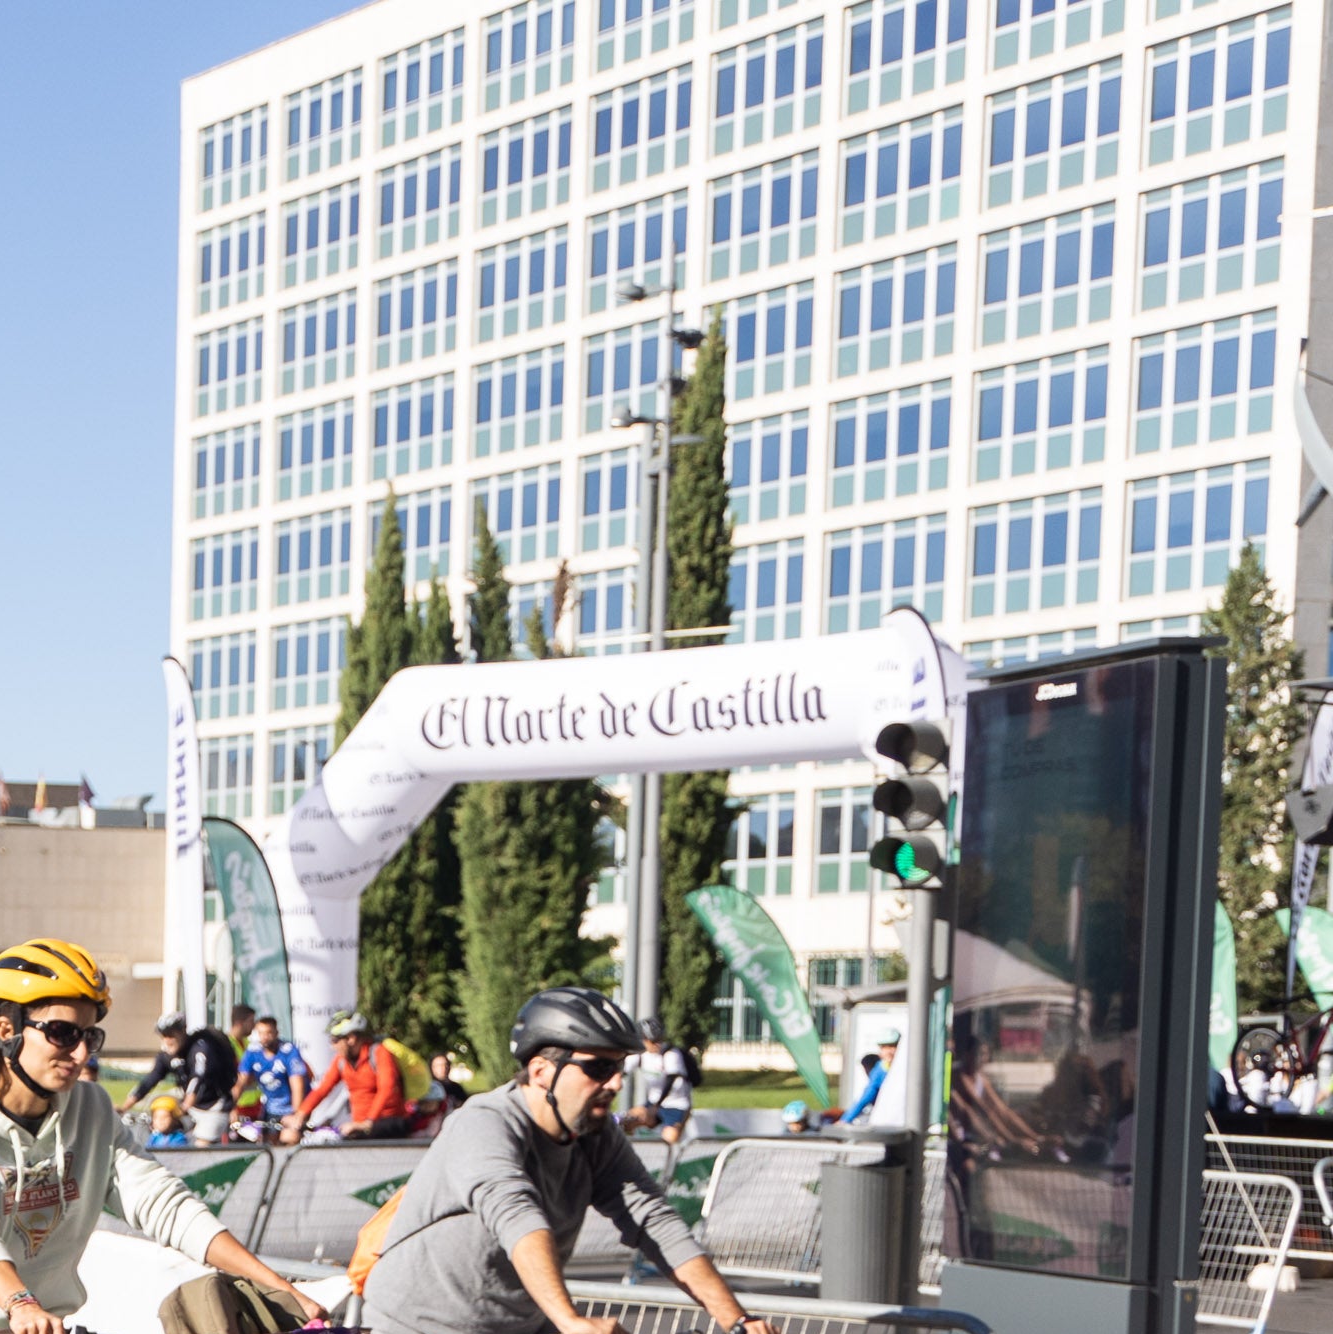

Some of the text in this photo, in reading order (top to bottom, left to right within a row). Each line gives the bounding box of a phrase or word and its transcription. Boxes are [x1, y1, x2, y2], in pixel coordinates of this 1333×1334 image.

[421, 671, 828, 750] El Norte de Castilla
